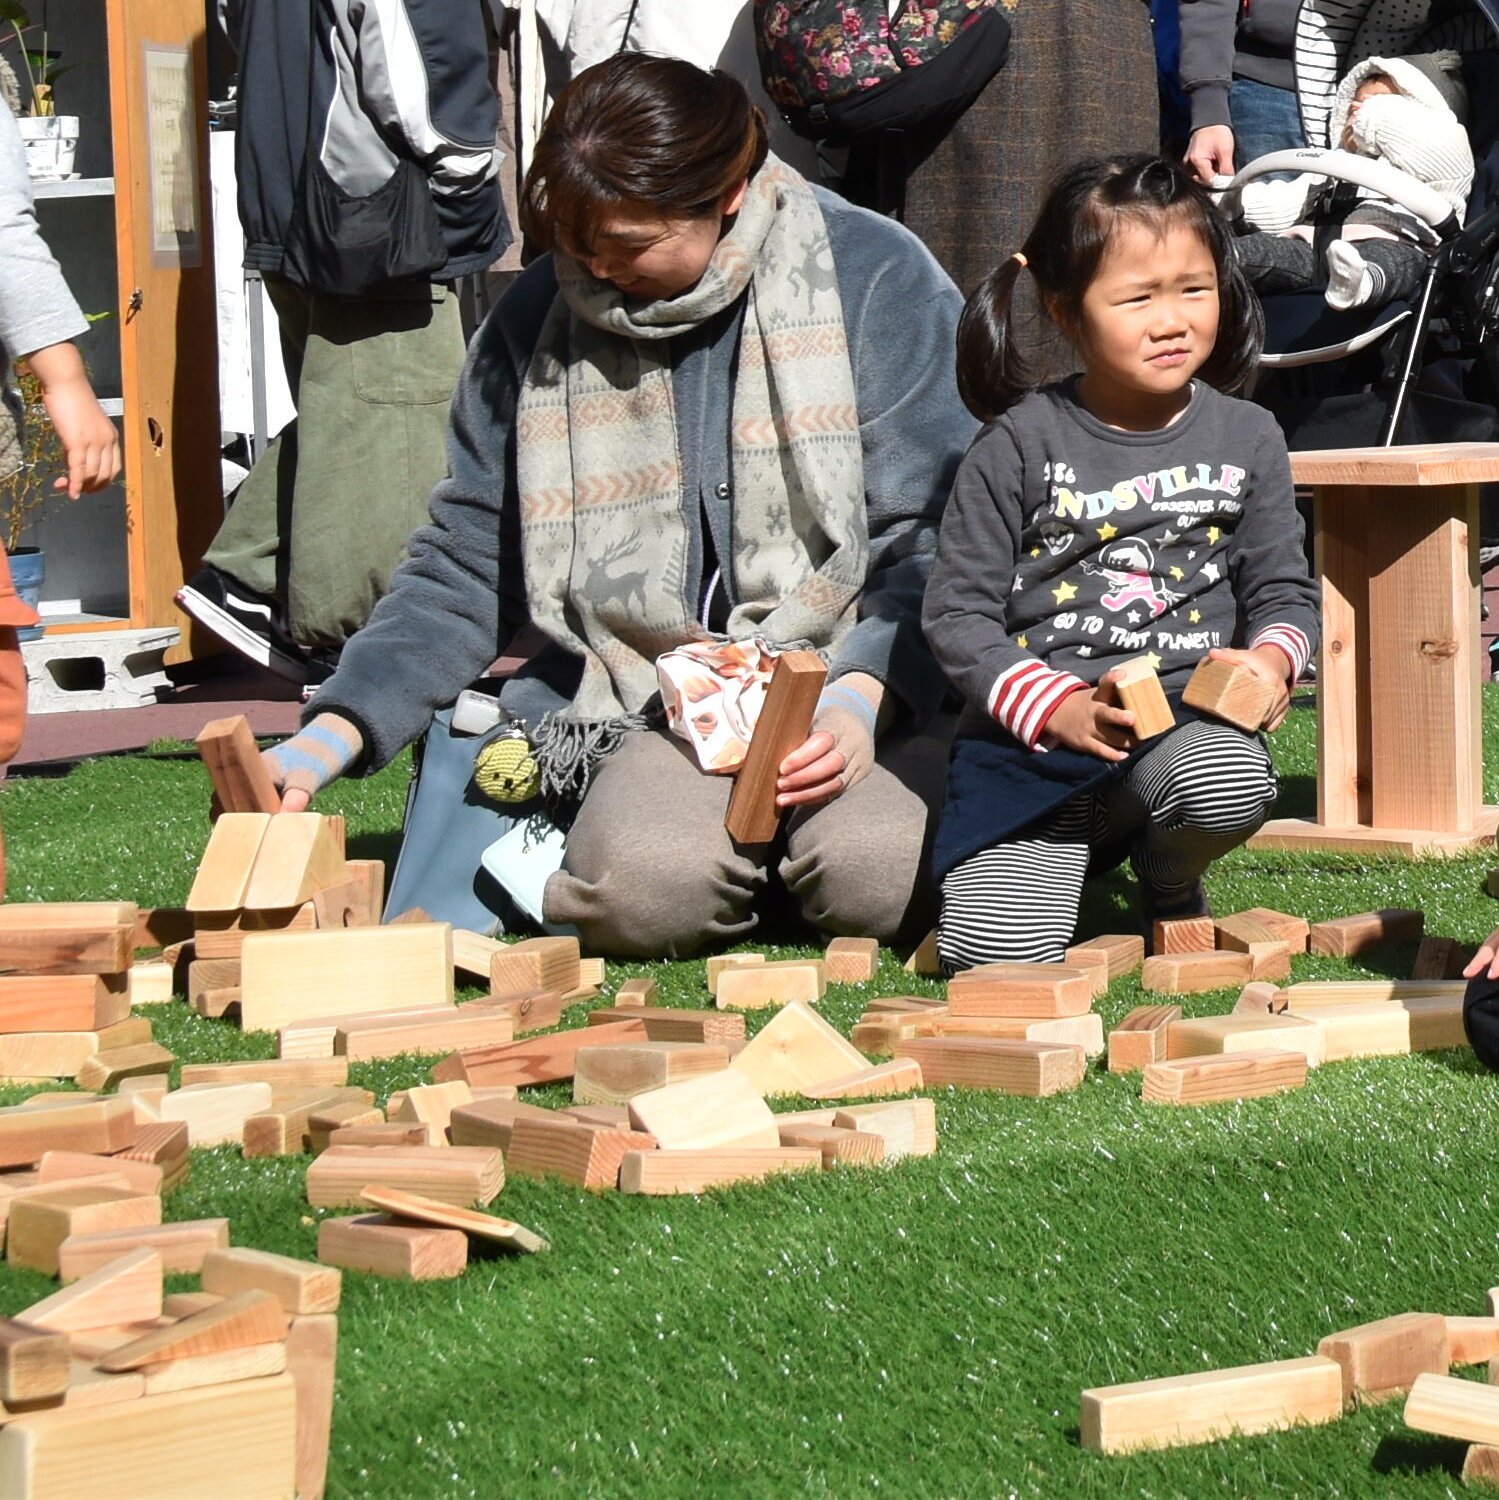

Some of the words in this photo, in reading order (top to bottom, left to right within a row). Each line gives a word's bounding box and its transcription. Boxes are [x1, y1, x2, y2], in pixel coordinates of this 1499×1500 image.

[1049, 463, 1246, 519] NDSVILLE
[1053, 612, 1079, 630] GO
[1081, 615, 1104, 635] TO
[1109, 625, 1151, 649] THAT
